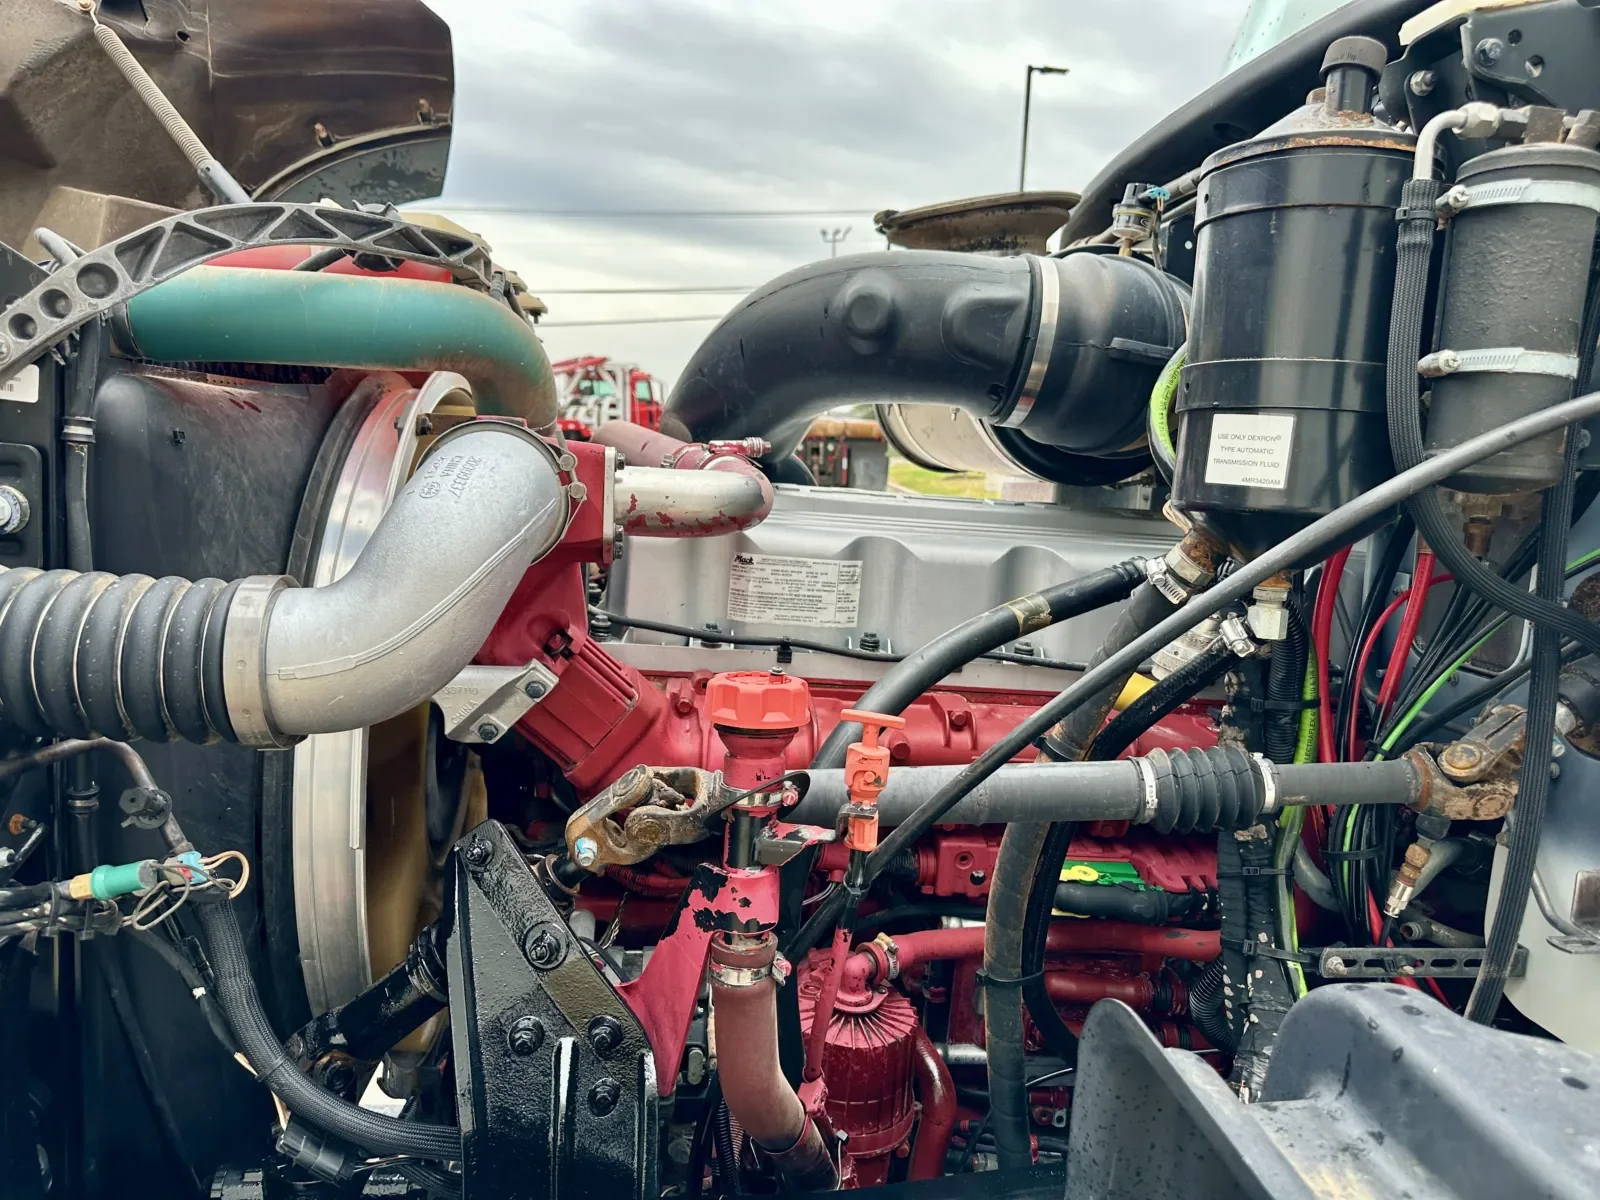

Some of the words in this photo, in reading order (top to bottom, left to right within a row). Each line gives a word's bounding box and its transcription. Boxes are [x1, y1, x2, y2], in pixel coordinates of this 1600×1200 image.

[1230, 433, 1246, 441] ONLY
[1220, 445, 1236, 453] TYPE
[1236, 447, 1274, 455] AUTOMATIC
[1213, 458, 1258, 467] TRANSMISSION
[1259, 460, 1280, 469] FLUID
[734, 554, 755, 566] Mack
[451, 699, 479, 724] CHINA
